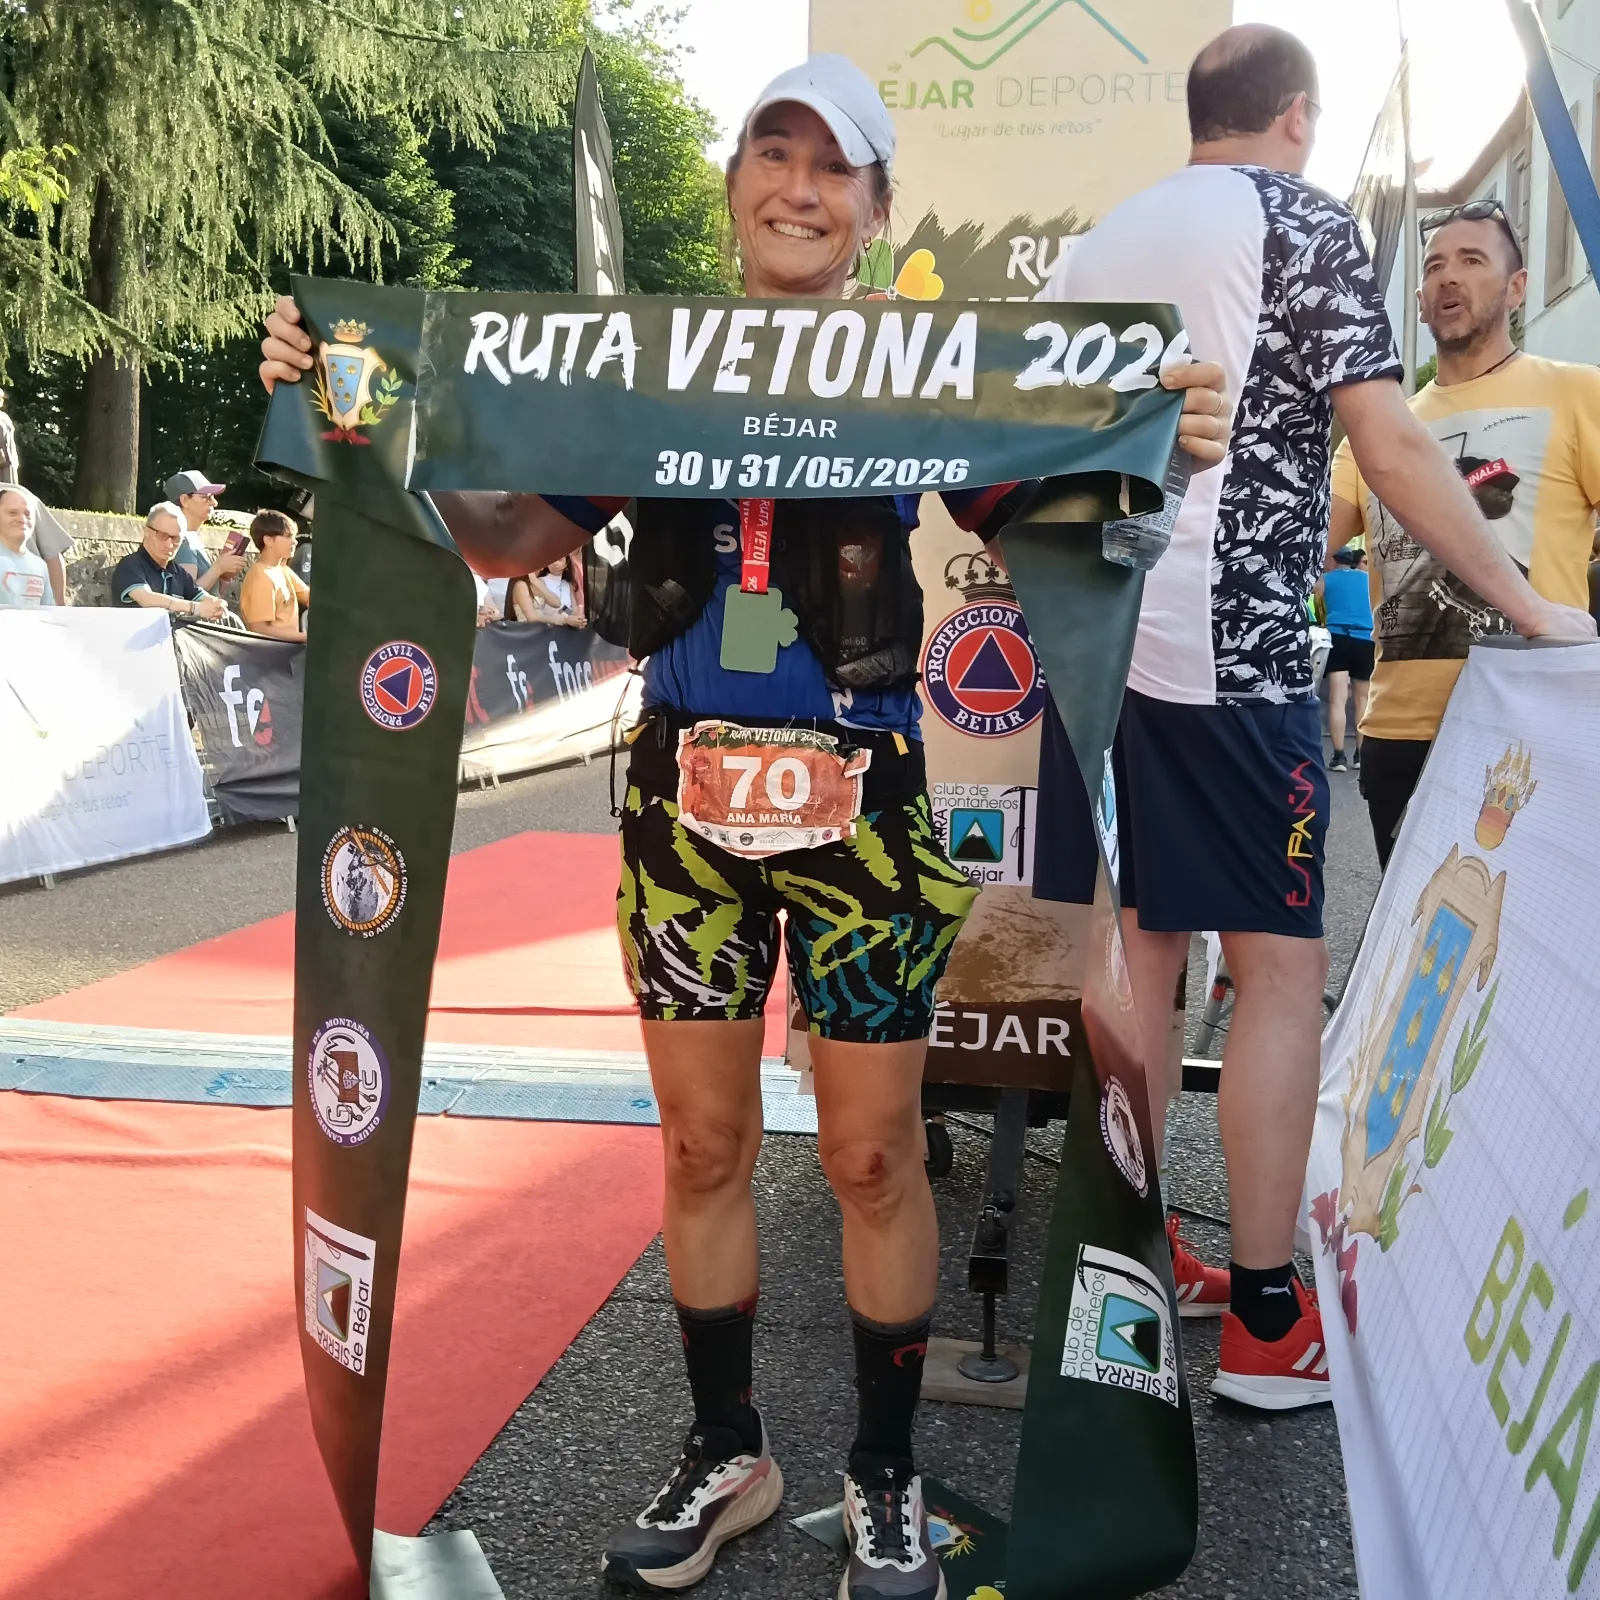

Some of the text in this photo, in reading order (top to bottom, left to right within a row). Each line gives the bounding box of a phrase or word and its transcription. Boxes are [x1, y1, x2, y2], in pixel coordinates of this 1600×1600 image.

[878, 61, 1187, 110] ÉJAR DEPORTE
[993, 122, 1014, 136] de
[1020, 121, 1045, 136] tus
[463, 311, 643, 391] RUTA
[668, 307, 978, 400] VETONA
[743, 412, 838, 438] BÉJAR
[654, 450, 702, 486] 30
[710, 459, 733, 489] y
[1468, 462, 1502, 486] INALS
[752, 530, 768, 564] VETO
[928, 608, 1018, 683] PROTECCION
[364, 645, 413, 726] PROTECCION CIVIL
[754, 729, 796, 743] VETONA
[952, 709, 1024, 733] BEJAR
[722, 755, 811, 811] 70
[933, 782, 988, 797] club de
[726, 810, 802, 825] ANA MARÍA
[933, 796, 1019, 810] montañeros
[362, 931, 374, 939] 50
[376, 876, 408, 935] ANIVERSARIO
[312, 1029, 322, 1045] DE
[325, 1017, 370, 1040] MONTAÑA
[928, 1000, 1072, 1057] ÉJAR
[349, 1116, 380, 1144] GRUPO
[351, 1277, 371, 1373] de Béjar
[1062, 1306, 1085, 1378] club de
[1079, 1271, 1107, 1380] montañeros
[1094, 1362, 1162, 1396] SIERRA
[1162, 1376, 1176, 1404] de
[1464, 1187, 1600, 1593] BÉJA
